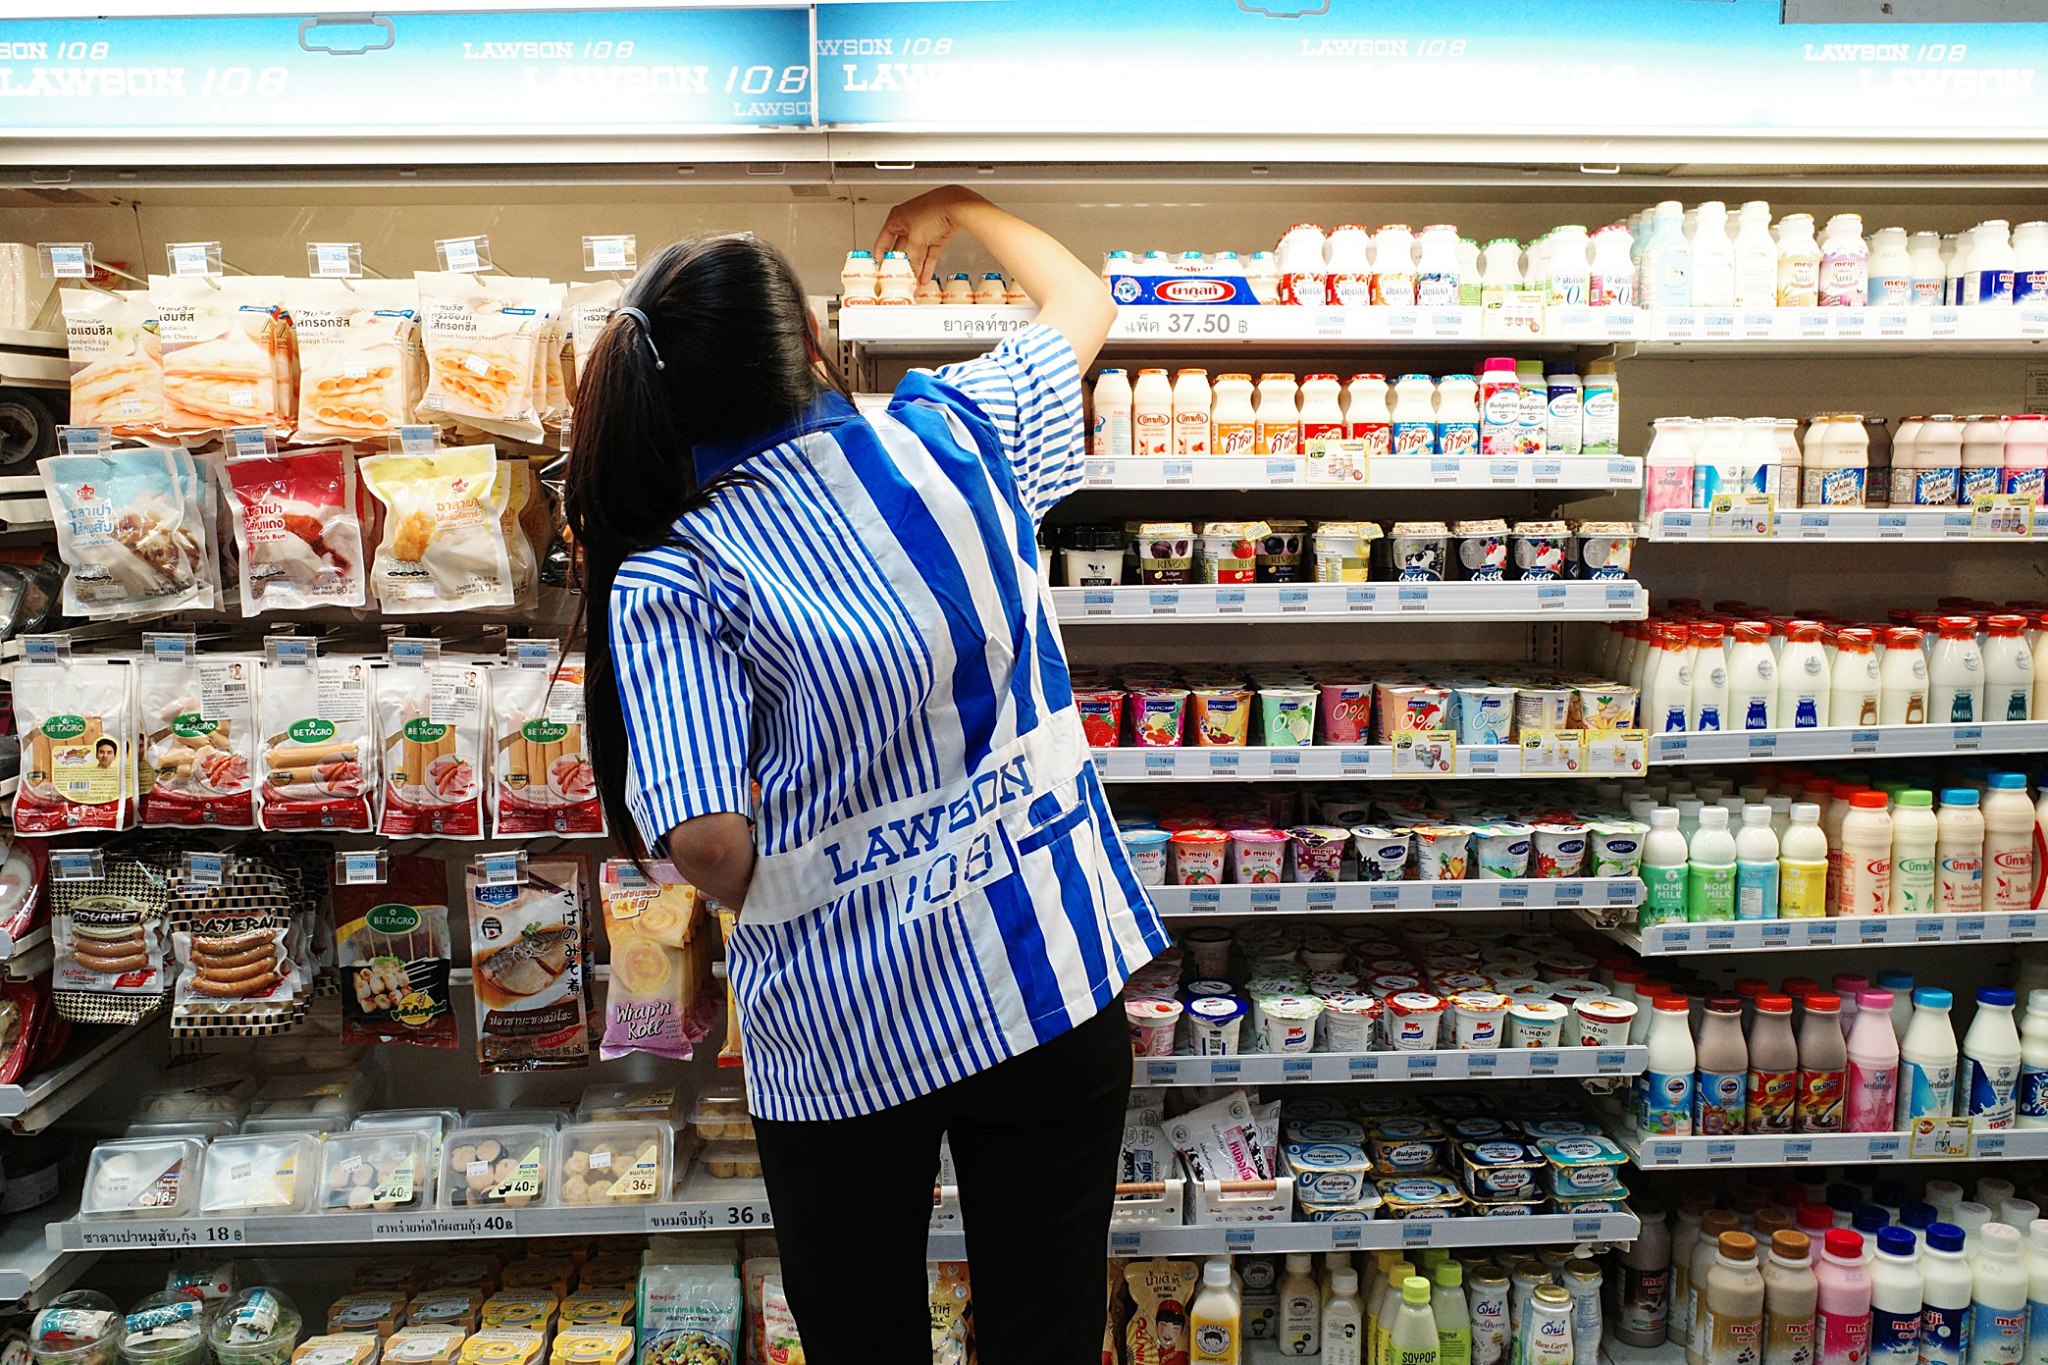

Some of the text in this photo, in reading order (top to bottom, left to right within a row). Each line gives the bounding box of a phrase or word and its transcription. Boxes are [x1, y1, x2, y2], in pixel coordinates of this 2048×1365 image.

[57, 41, 110, 60] 108
[463, 41, 634, 59] LAWSON 108
[902, 38, 953, 55] 108
[1300, 39, 1468, 57] LAWSON 108
[1803, 44, 1967, 62] LAWSON 108
[0, 66, 290, 97] LAWSON 108
[724, 66, 808, 95] 108
[1883, 279, 1909, 289] meiji
[1915, 281, 1941, 292] meiji
[1167, 313, 1231, 334] 37.50
[1333, 702, 1365, 721] 0%
[1953, 710, 1972, 721] Milk
[2008, 710, 2027, 720] Milk
[1747, 717, 1766, 728] Milk
[1796, 715, 1817, 726] Milk
[46, 722, 84, 732] BETAGRO
[293, 725, 333, 737] BETAGRO
[408, 726, 444, 736] BETAGRO
[527, 726, 566, 736] BETAGRO
[824, 755, 1033, 885] LAWSON
[1136, 851, 1159, 860] meiji
[1188, 850, 1211, 859] meiji
[1253, 849, 1275, 858] meiji
[1310, 846, 1334, 856] meiji
[905, 832, 993, 914] 108
[480, 885, 513, 894] KING
[480, 893, 513, 902] CHEF
[1657, 891, 1681, 900] MILK
[1707, 891, 1733, 900] MILK
[190, 916, 275, 934] BAYERN
[374, 914, 417, 927] BETAGRO
[561, 889, 584, 996] さばのみそ煮
[627, 1018, 663, 1041] Roll
[1395, 1149, 1429, 1160] Bulgaria
[1492, 1172, 1527, 1182] Bulgaria
[1575, 1171, 1610, 1181] Bulgaria
[1322, 1179, 1350, 1188] Bulgaria
[650, 1206, 754, 1228] ขนมจีบกุ้ง 36
[376, 1216, 505, 1235] สาหร่ายห่อไก่ผสมกุ้ง 40
[83, 1227, 197, 1247] ซาลาเปาหมูสับ,กุ้ง
[206, 1226, 230, 1242] 18
[1402, 1350, 1437, 1363] SOYPOP
